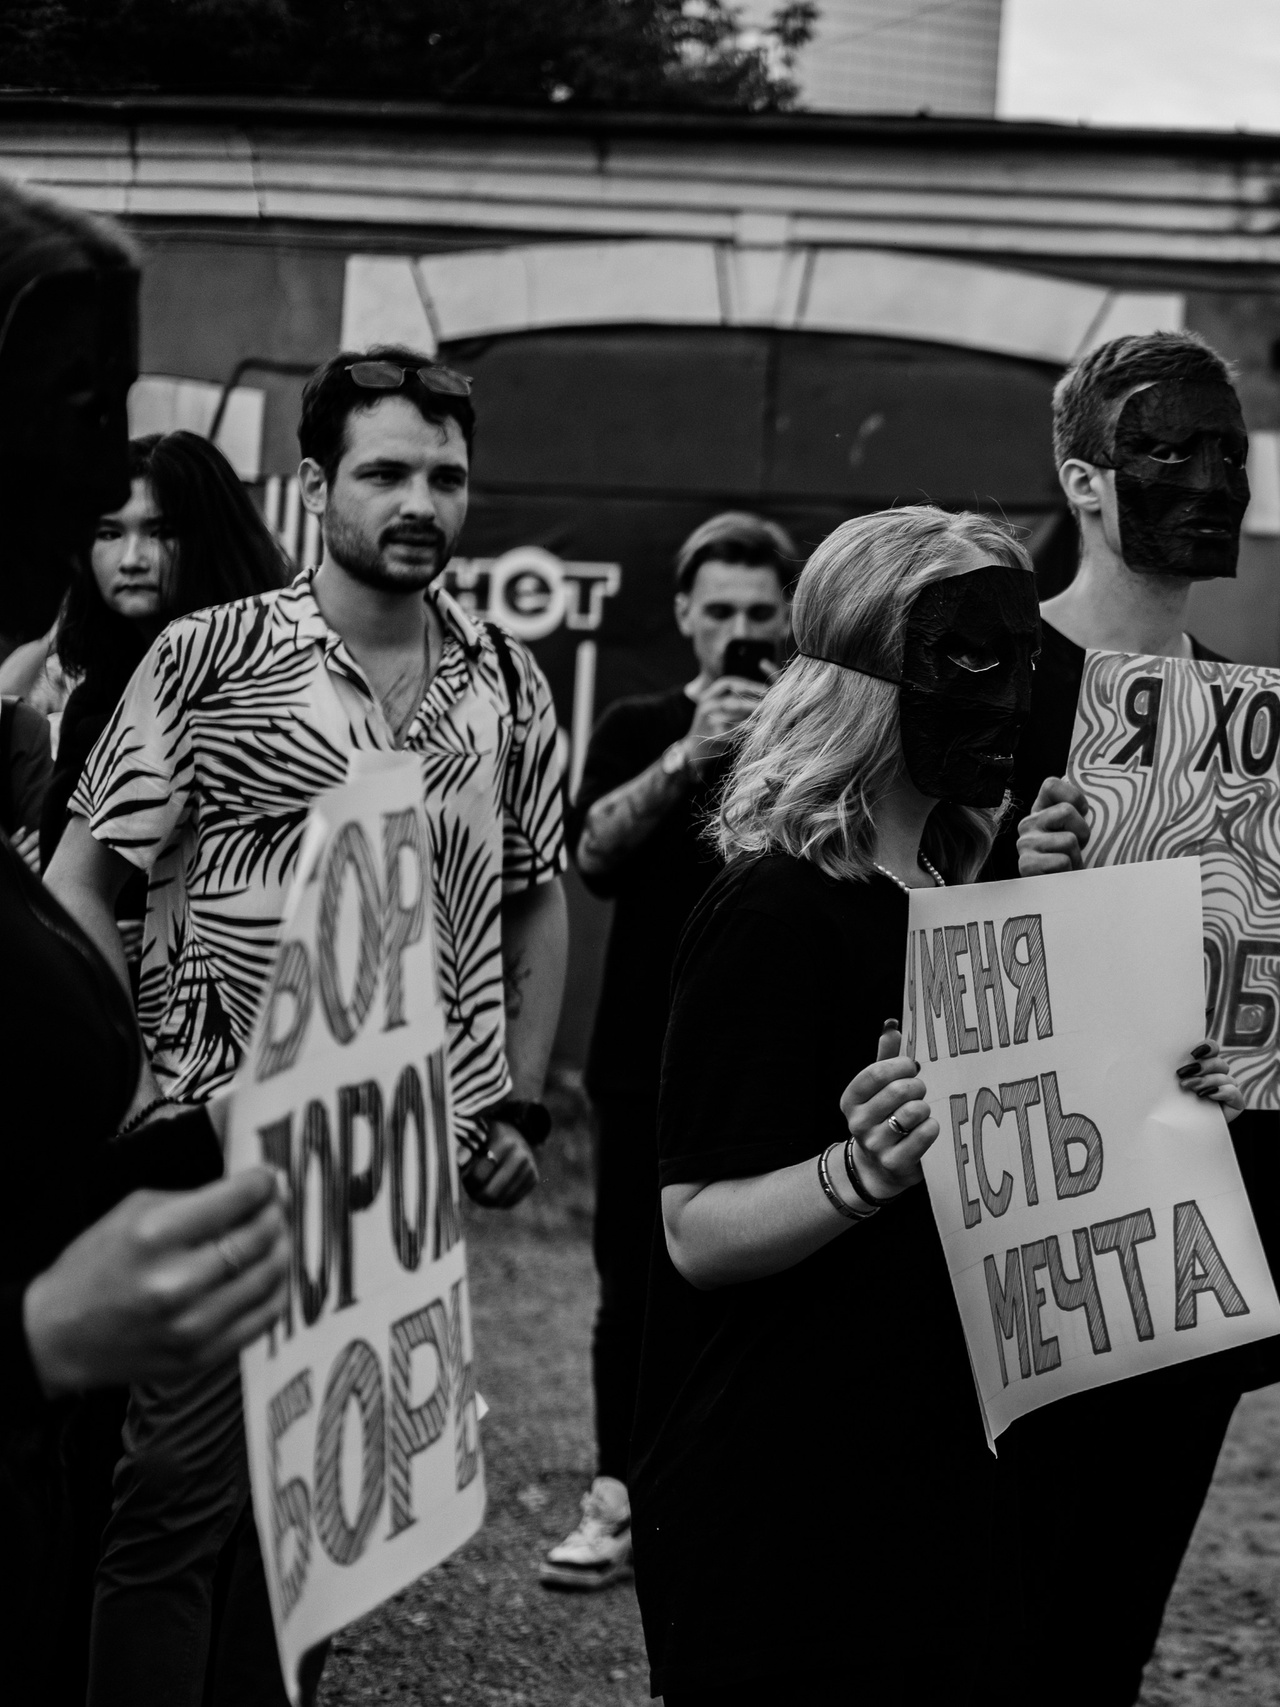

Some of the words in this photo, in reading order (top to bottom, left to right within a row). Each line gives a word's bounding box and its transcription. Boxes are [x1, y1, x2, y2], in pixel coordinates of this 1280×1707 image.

[1110, 677, 1163, 767] Я
[920, 913, 1053, 1062] МЕНЯ
[949, 1071, 1104, 1230] ЕСТЬ
[983, 1199, 1251, 1389] МЕЧТА
